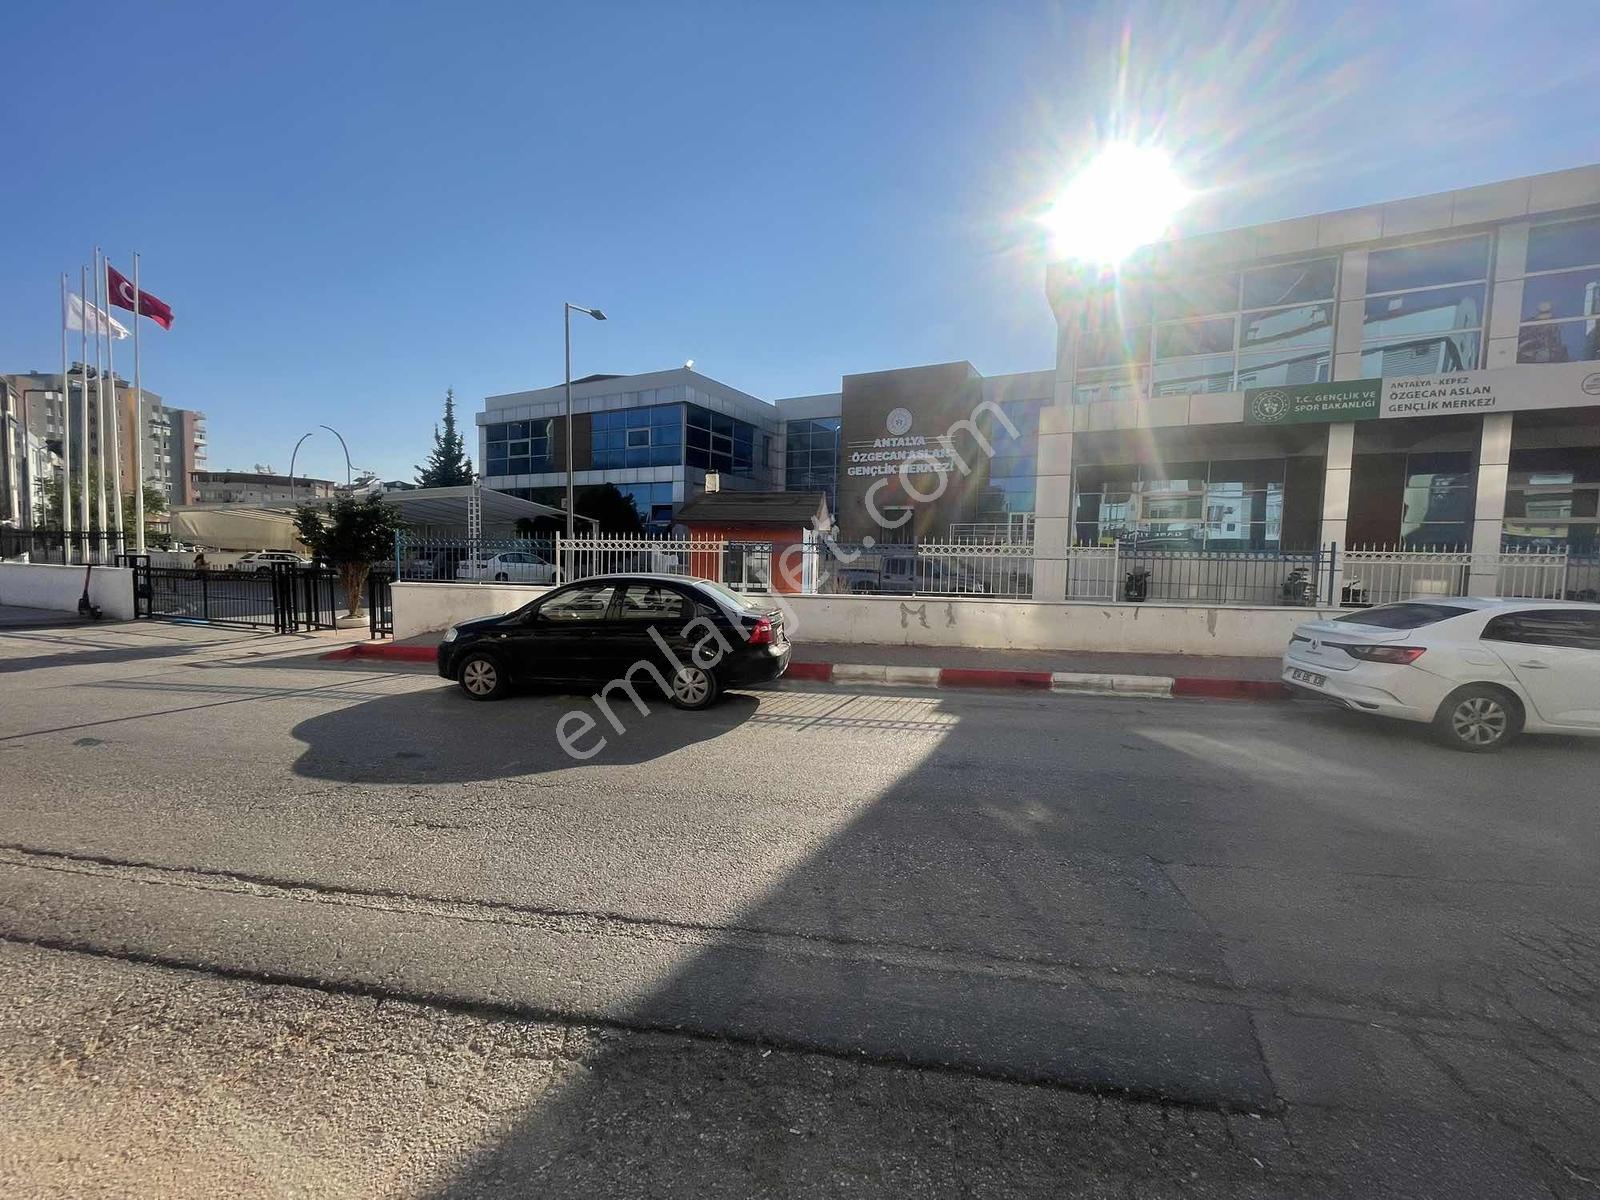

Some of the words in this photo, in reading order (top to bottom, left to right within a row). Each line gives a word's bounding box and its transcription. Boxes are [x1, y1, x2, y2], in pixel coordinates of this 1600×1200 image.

[1391, 379, 1431, 389] ANTALYA
[1439, 376, 1469, 386] KEPEZ
[1315, 391, 1359, 402] GENÇLİK
[1362, 390, 1376, 398] VE
[1389, 387, 1447, 401] ÖZGECAN
[1449, 385, 1491, 397] ASLAN
[1294, 403, 1320, 413] SPOR
[1322, 399, 1375, 411] BAKANLIĞI
[1388, 400, 1439, 413] GENÇLİK
[1441, 396, 1496, 409] MERKEZİ
[873, 436, 926, 447] ANTALYA
[851, 450, 906, 463] ÖZGECAN
[847, 462, 898, 477] GENÇLİK
